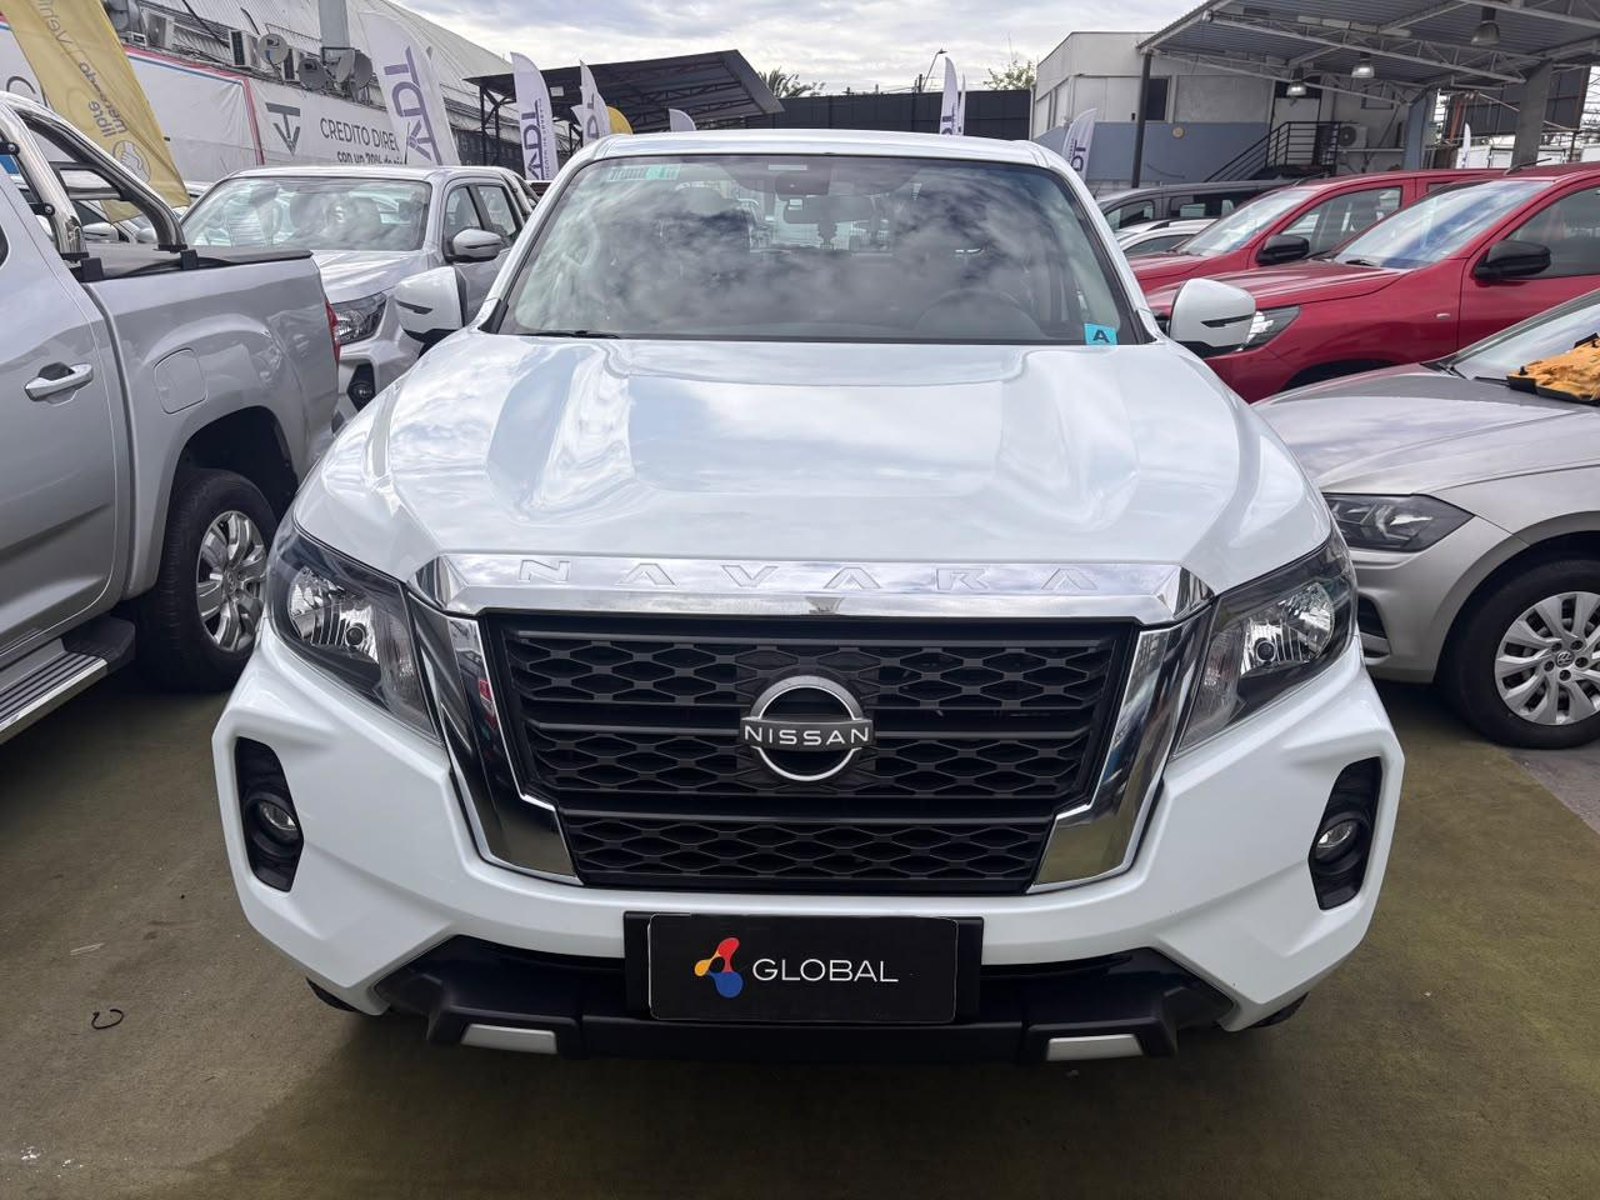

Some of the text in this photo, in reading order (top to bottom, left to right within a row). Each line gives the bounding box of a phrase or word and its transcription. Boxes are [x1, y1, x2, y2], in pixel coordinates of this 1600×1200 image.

[320, 117, 371, 146] CREDITO
[1093, 329, 1111, 343] A
[518, 559, 1099, 590] NAVARA
[744, 725, 869, 746] NISSAN
[752, 958, 899, 982] GLOBAL
